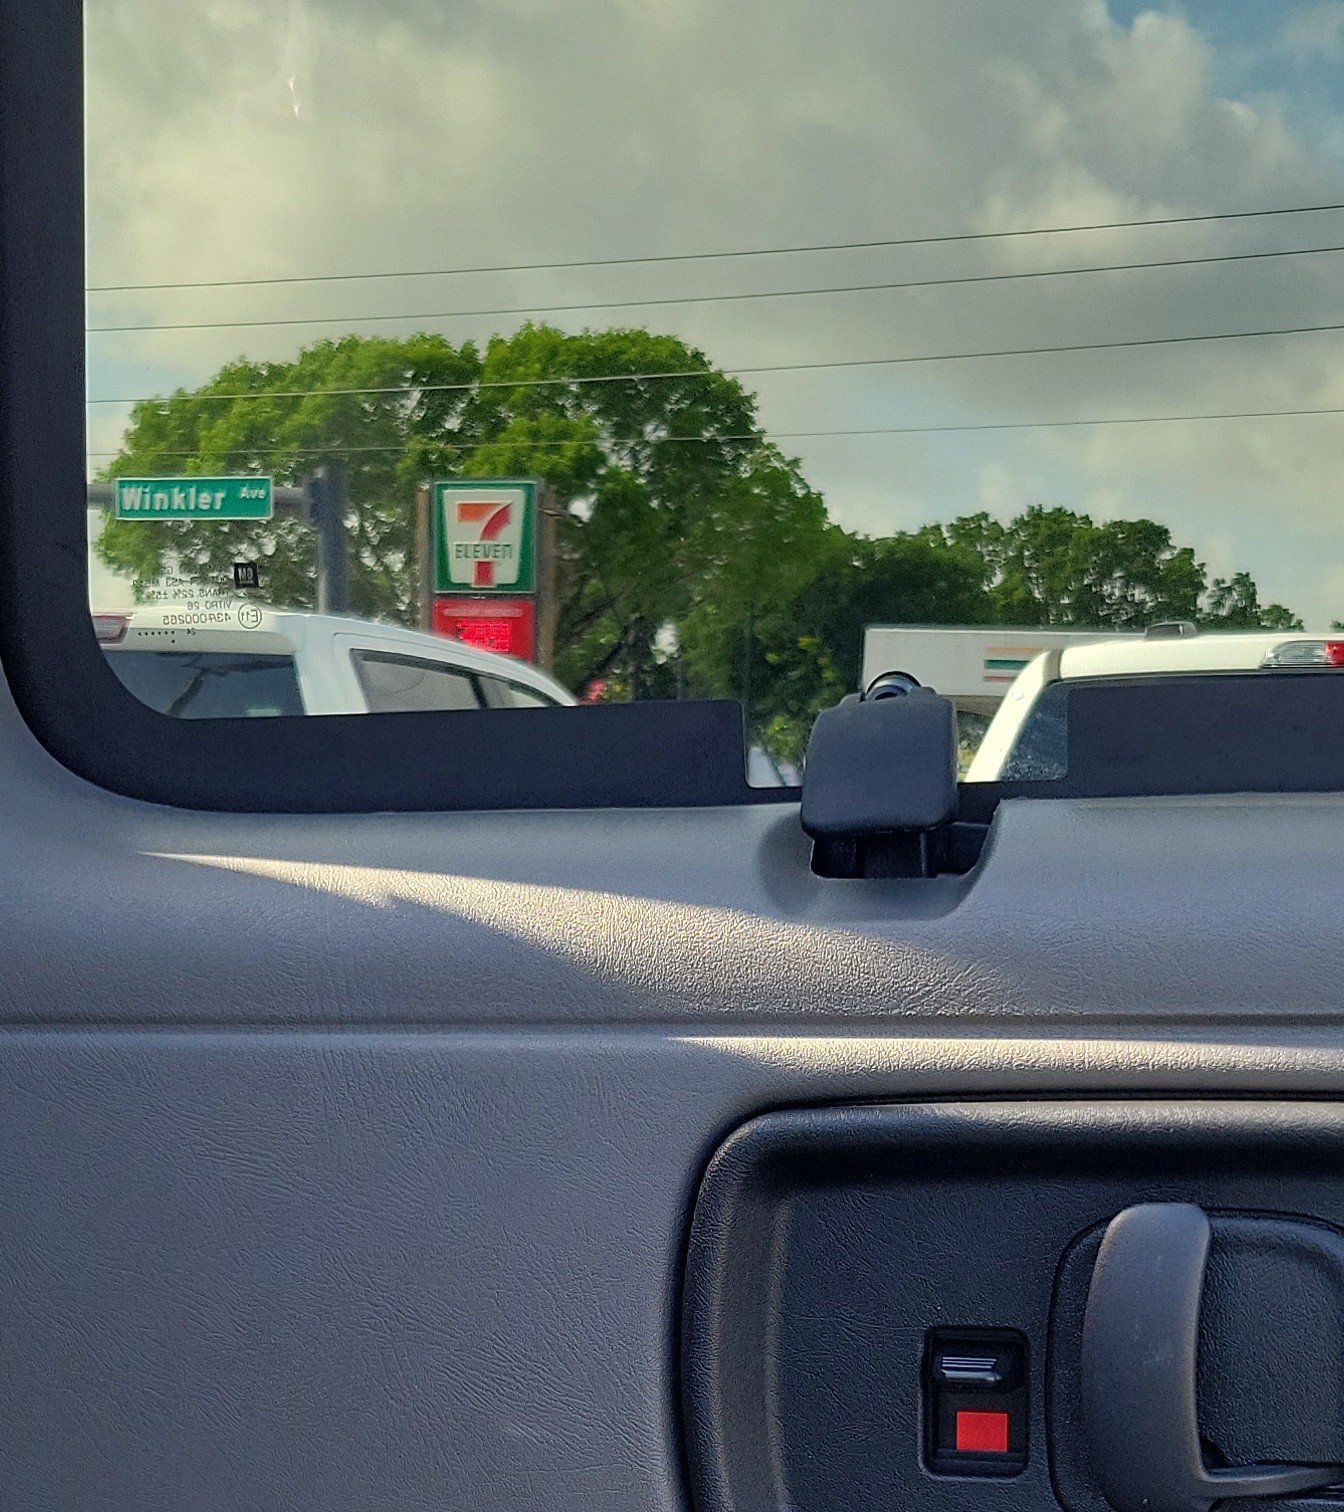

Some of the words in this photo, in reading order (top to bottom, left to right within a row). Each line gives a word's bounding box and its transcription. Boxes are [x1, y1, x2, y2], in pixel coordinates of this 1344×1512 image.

[122, 485, 226, 511] Winkler
[239, 487, 266, 499] Ave
[457, 501, 512, 586] 7
